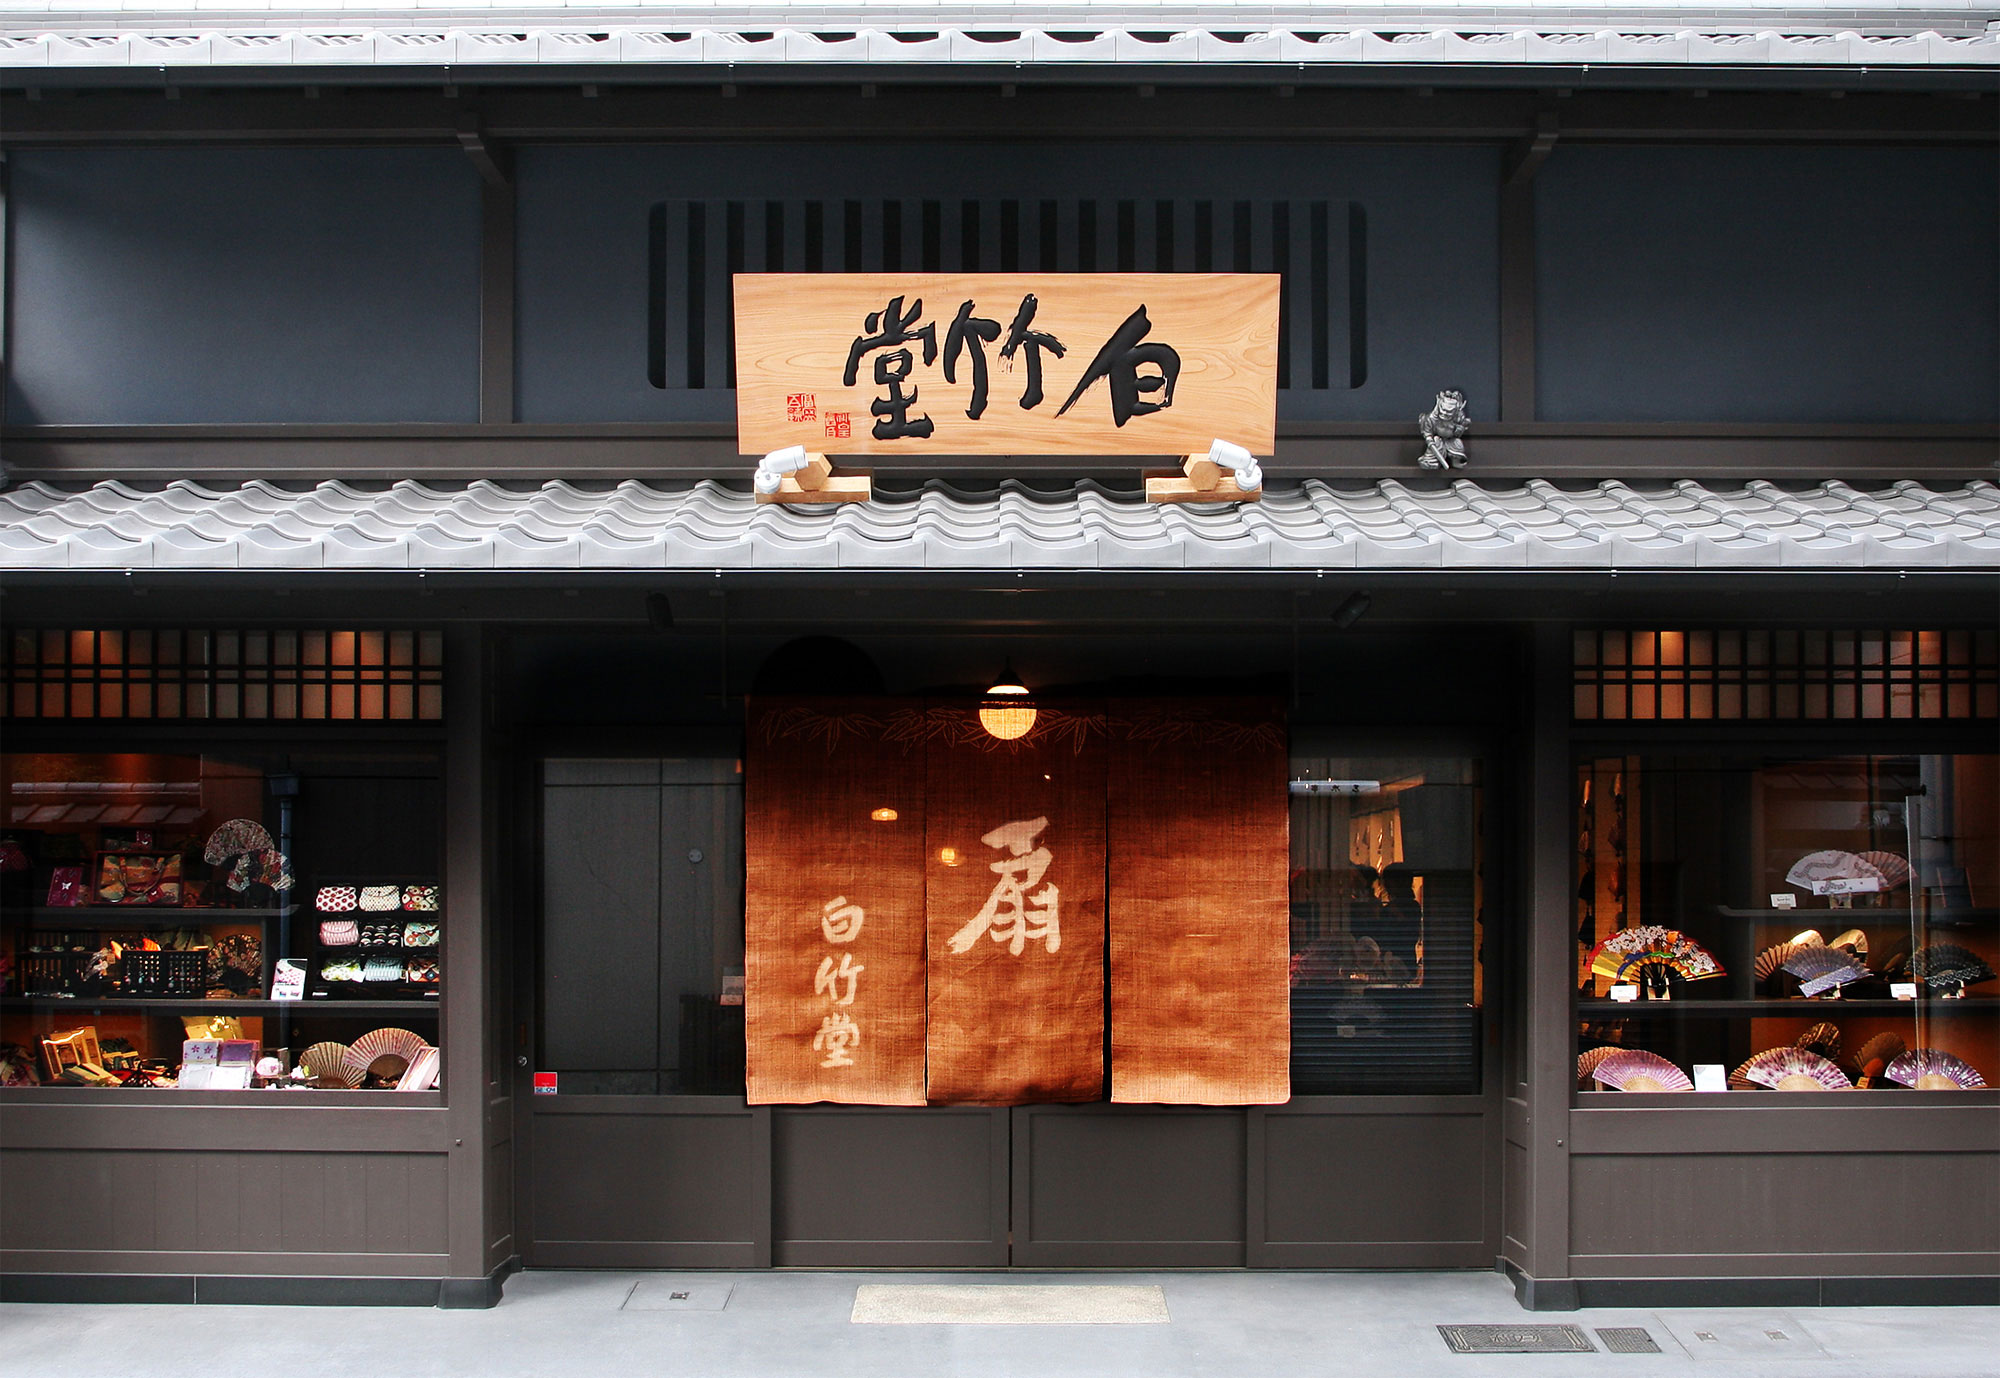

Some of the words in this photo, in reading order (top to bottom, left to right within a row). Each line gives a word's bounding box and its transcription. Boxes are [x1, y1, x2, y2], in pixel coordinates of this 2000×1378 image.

[843, 293, 1181, 440] 白竹堂
[947, 816, 1062, 956] 扇
[814, 895, 865, 1068] 白竹堂
